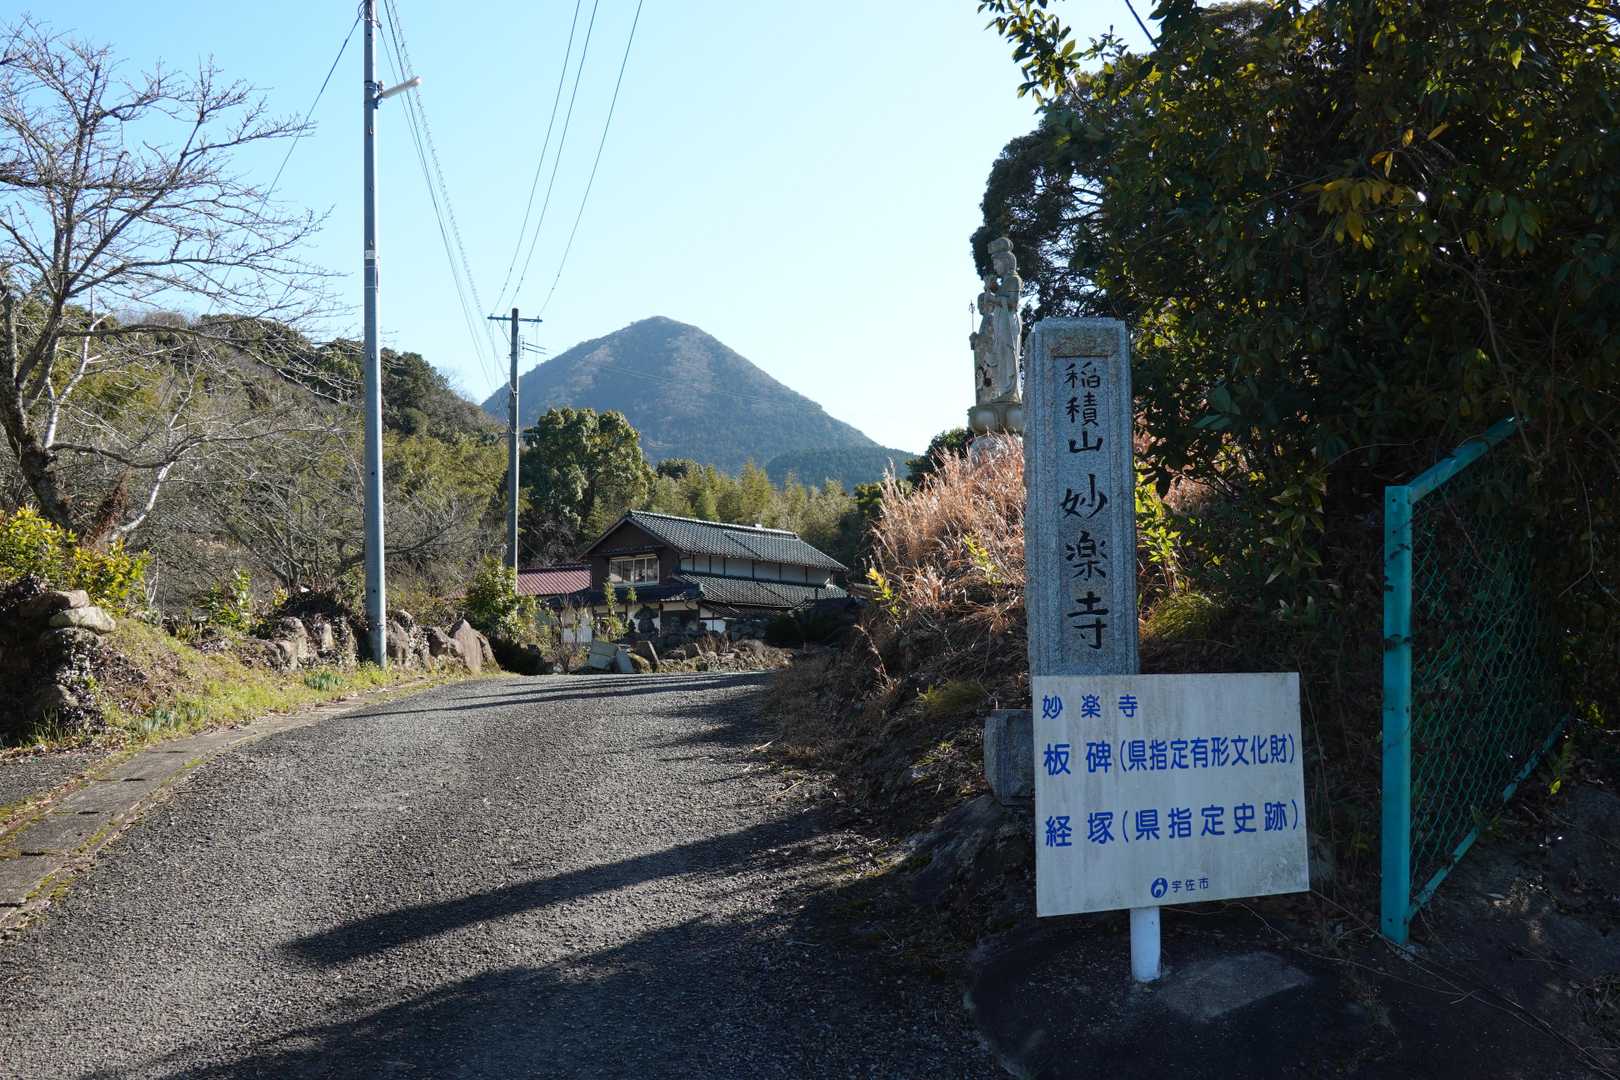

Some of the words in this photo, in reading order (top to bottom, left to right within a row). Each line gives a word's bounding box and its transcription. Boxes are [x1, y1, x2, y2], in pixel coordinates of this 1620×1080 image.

[1060, 361, 1109, 649] 稲積山妙楽寺
[1042, 694, 1138, 719] 妙楽寺
[1171, 878, 1209, 893] 宇佐市
